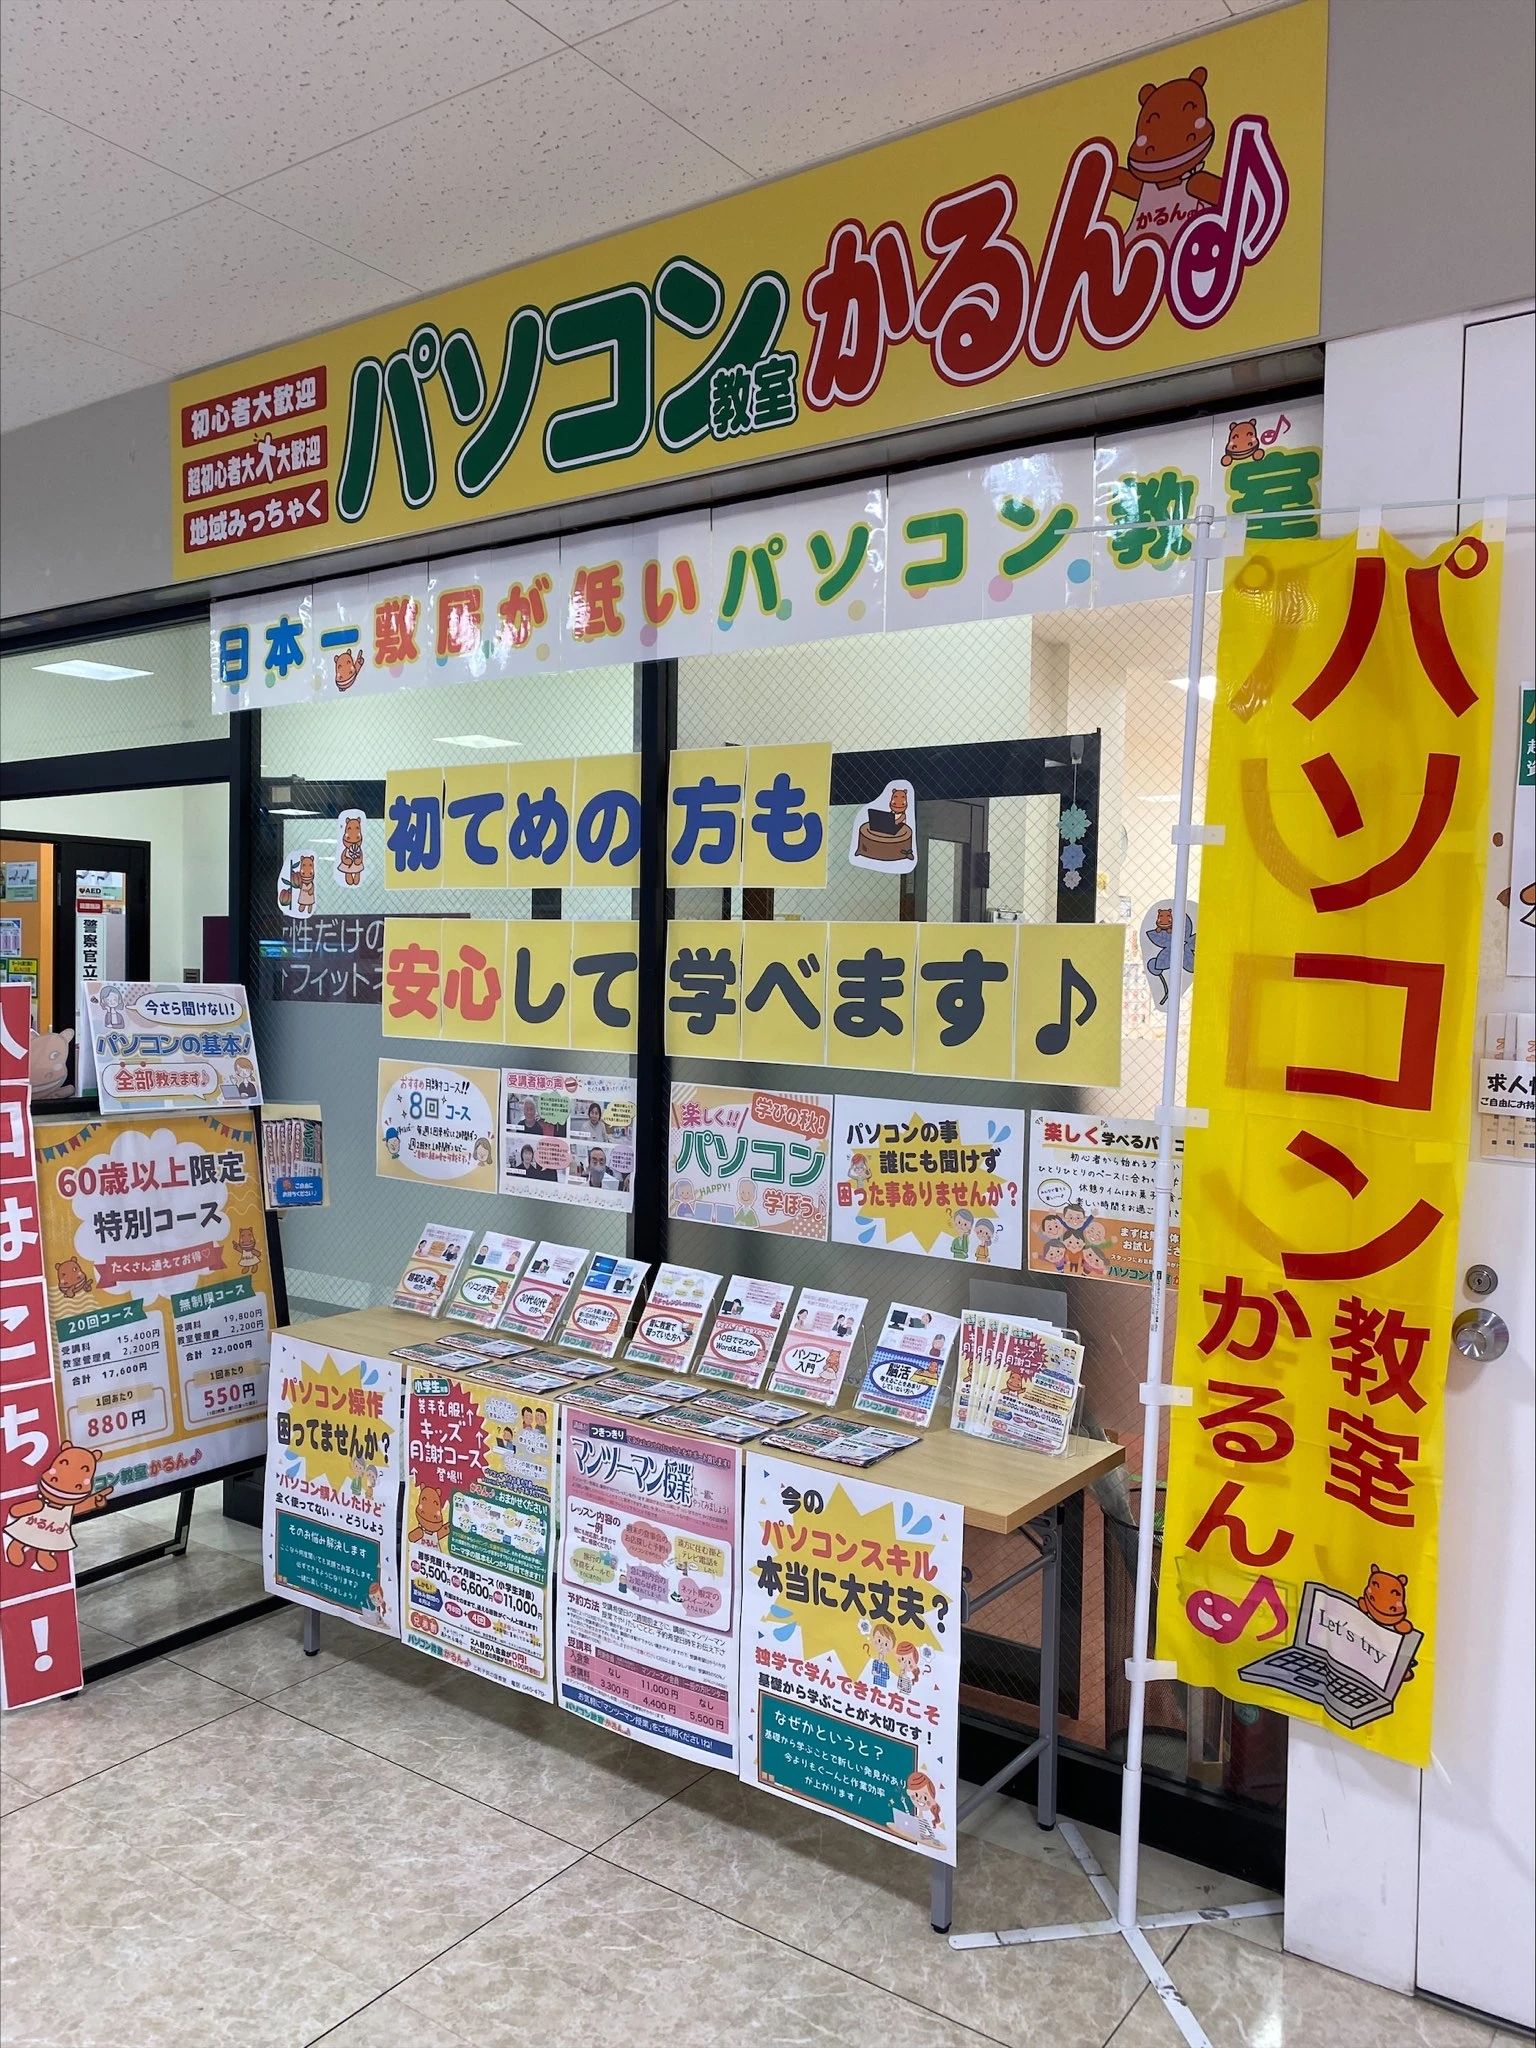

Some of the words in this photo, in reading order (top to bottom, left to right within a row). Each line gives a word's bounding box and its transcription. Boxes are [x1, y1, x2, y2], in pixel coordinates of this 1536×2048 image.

[336, 255, 791, 523] パソコン
[707, 351, 798, 440] 教室
[803, 136, 1166, 412] かるん
[191, 377, 317, 440] 初心者大歓迎
[190, 488, 321, 546] 地域みっちゃく
[387, 772, 823, 872] 初めての方も
[283, 918, 384, 954] 性だけの
[83, 919, 98, 981] 警察官立
[144, 1000, 236, 1016] 今さら聞けない！
[97, 1033, 252, 1057] パソコンの基本！
[1281, 537, 1488, 1528] パソコン教室
[115, 1070, 201, 1091] 全部教えます
[508, 1074, 564, 1090] 受講者様の声
[682, 1102, 739, 1128] 楽しく!!
[755, 1097, 825, 1134] 学びの秋！
[847, 1119, 958, 1145] パソコンの事
[676, 1130, 825, 1187] パソコン
[879, 1147, 1001, 1174] 誰にも聞けず
[57, 1152, 246, 1198] 60歳以上限定
[700, 1184, 731, 1196] HAPPY!
[763, 1189, 814, 1218] 学ぼう
[837, 1181, 1018, 1208] 困った事ありませんか？
[93, 1200, 222, 1243] 特別コース
[178, 1284, 245, 1312] 無制限コース
[68, 1306, 134, 1333] 20回コース
[175, 1319, 201, 1334] 受講料
[223, 1306, 262, 1325] 19,800円
[230, 1317, 263, 1335] 2,200円
[117, 1326, 160, 1347] 15,400円
[122, 1338, 159, 1357] 2,200円
[177, 1327, 219, 1347] 教室管理費
[211, 1337, 252, 1358] 22,000円
[185, 1349, 202, 1362] 合計
[716, 1343, 756, 1358] Word&Excel
[792, 1349, 825, 1363] パソコン
[71, 1372, 91, 1387] 合計
[102, 1360, 147, 1382] 17,600円
[210, 1363, 243, 1381] 1回あたり
[795, 1361, 815, 1374] 入門
[886, 1362, 912, 1380] 脳活
[95, 1388, 133, 1408] 1回あたり
[203, 1377, 255, 1410] 550円
[280, 1377, 384, 1420] パソコン操作
[418, 1398, 464, 1418] 苦手克服!
[1184, 1275, 1312, 1567] かるん
[86, 1404, 146, 1440] 880円
[420, 1419, 466, 1443] キッズ
[591, 1427, 625, 1440] つきっきり
[277, 1412, 390, 1464] 困ってませんか？
[410, 1439, 482, 1469] 月謝コース
[570, 1435, 695, 1507] マンツーマン授業
[279, 1474, 382, 1517] パソコン購入したけど
[780, 1486, 824, 1515] 今の
[25, 1516, 57, 1534] かるん
[275, 1492, 384, 1536] 全く使ってない・・どうしよう
[570, 1503, 621, 1527] レッスン内容の
[587, 1521, 604, 1534] 一例
[288, 1524, 367, 1558] そのお悩み解決します
[761, 1519, 938, 1582] パソコンスキル
[567, 1592, 600, 1613] 予約方法
[757, 1555, 949, 1634] 本当に大丈夫？
[567, 1636, 592, 1654] 受講料
[1317, 1607, 1355, 1646] Let's
[1359, 1637, 1388, 1664] try
[608, 1667, 621, 1679] なし
[699, 1699, 714, 1710] なし
[755, 1646, 941, 1726] 独学で学んできた方こそ
[758, 1672, 934, 1746] 基礎から学ぶことが大切です！
[774, 1709, 884, 1761] なぜかというと？
[764, 1729, 907, 1790] 基礎から学ぶことで新しい発見があり
[783, 1752, 886, 1798] 今よりもぐーんと作業効率
[804, 1775, 863, 1805] が上がります！
